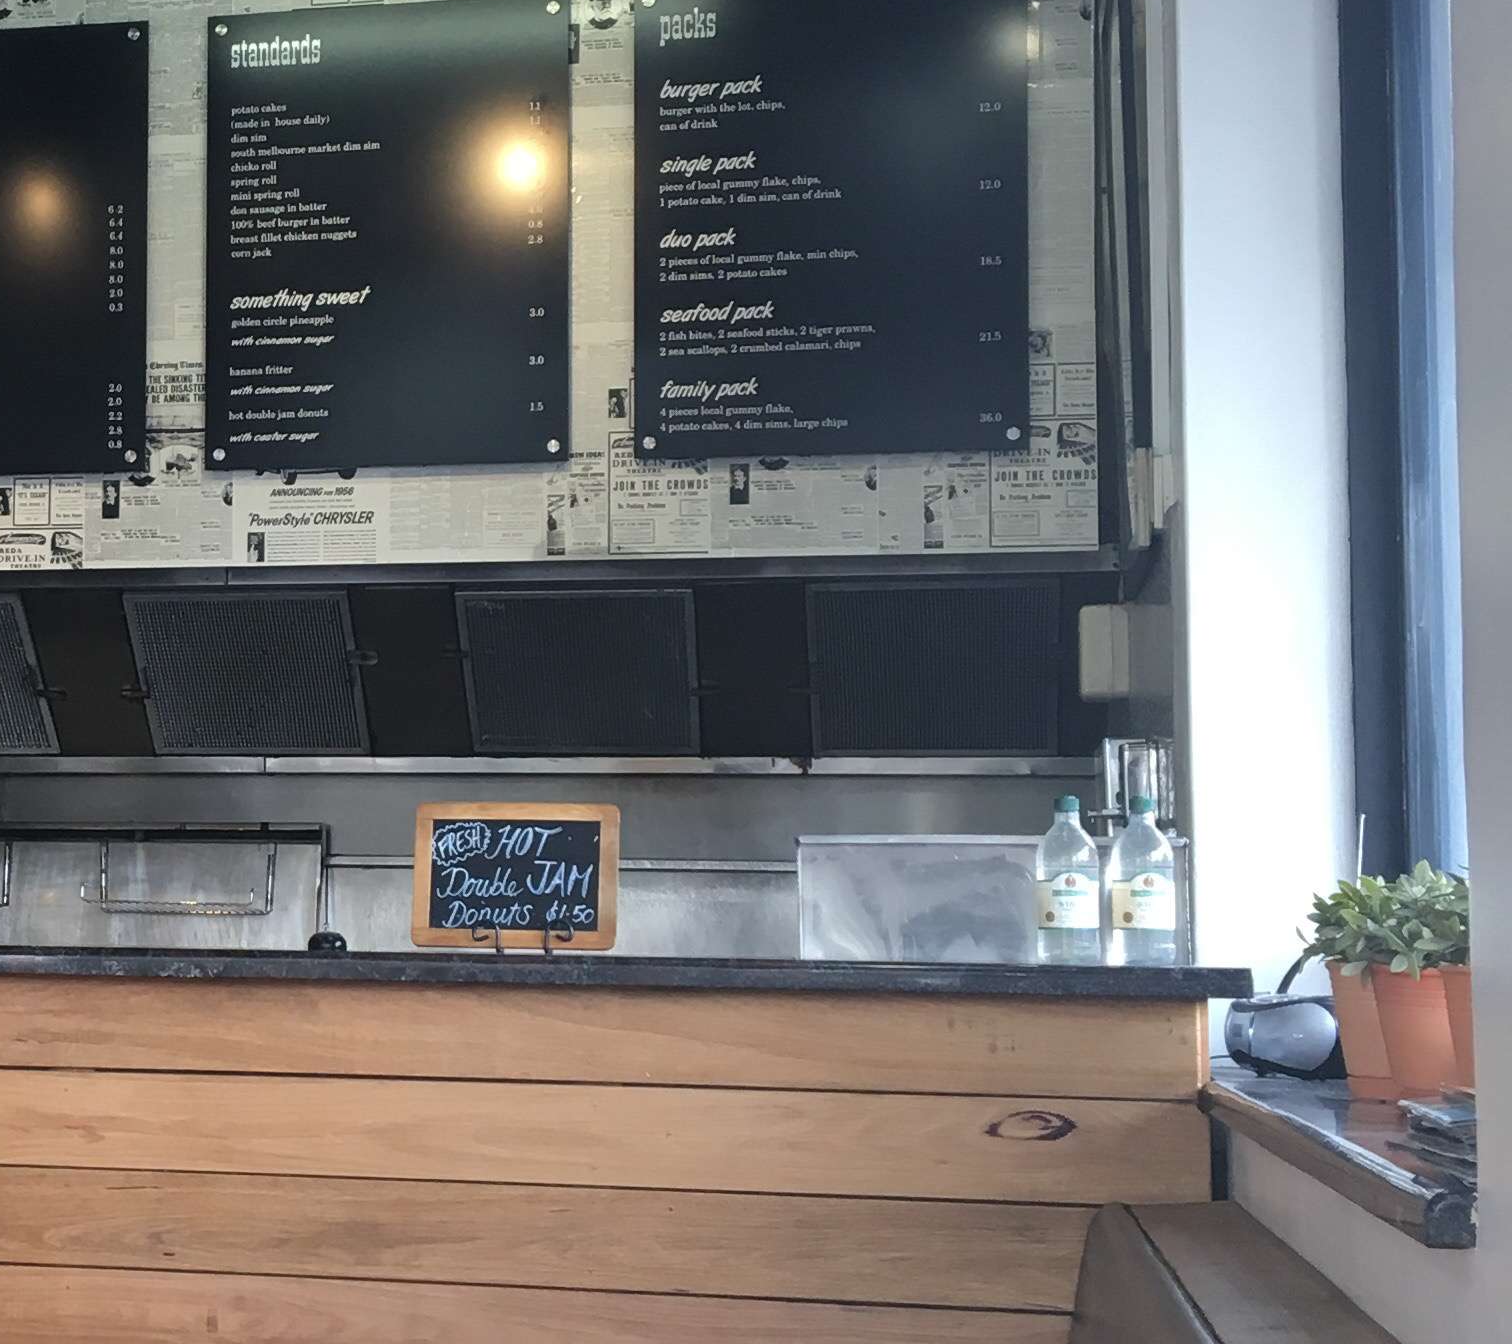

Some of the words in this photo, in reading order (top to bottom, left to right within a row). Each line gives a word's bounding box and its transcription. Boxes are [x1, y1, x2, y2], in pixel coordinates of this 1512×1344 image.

[659, 7, 717, 47] packs
[230, 33, 322, 69] standards
[660, 79, 720, 103] burger
[719, 74, 762, 100] pack
[659, 106, 693, 117] burger
[694, 104, 717, 114] with
[719, 102, 736, 114] the
[274, 116, 301, 126] house
[659, 123, 678, 131] can
[680, 119, 689, 130] of
[691, 118, 718, 129] drink
[660, 154, 710, 177] single
[714, 151, 757, 174] pack
[697, 179, 721, 190] local
[722, 178, 759, 191] gummy
[979, 179, 1002, 190] 12.0
[230, 189, 252, 201] mini
[253, 189, 283, 202] spring
[284, 188, 301, 199] roll
[283, 230, 319, 241] chicken
[321, 229, 357, 242] nuggets
[527, 234, 543, 245] 2.8
[660, 228, 691, 249] duo
[693, 228, 736, 251] pack
[726, 268, 757, 280] potato
[759, 267, 788, 278] cakes
[229, 288, 313, 313] something
[315, 285, 372, 307] sweet
[231, 315, 261, 328] golden
[262, 314, 288, 326] circle
[289, 314, 334, 328] pineapple
[529, 307, 545, 318] 3.0
[660, 302, 735, 324] seafood
[730, 301, 775, 325] pack
[979, 331, 1002, 342] 21.5
[229, 365, 264, 376] banana
[265, 364, 293, 376] fritter
[529, 355, 545, 366] 3.0
[230, 384, 253, 396] with
[254, 383, 301, 395] cinnamon
[303, 382, 334, 395] sugar
[660, 380, 716, 402] family
[715, 377, 758, 401] pack
[229, 409, 244, 420] hot
[245, 408, 276, 420] double
[277, 409, 297, 421] jam
[297, 408, 329, 419] donuts
[979, 412, 1002, 423] 36.0
[270, 487, 324, 496] ANNOUNCING
[334, 487, 354, 496] 1956
[613, 480, 635, 491] JOIN
[642, 480, 660, 490] THE
[667, 479, 709, 490] CROWDS
[313, 511, 374, 525] CHRYSLER
[438, 826, 482, 859] FRESH
[485, 824, 563, 860] HOT
[437, 867, 523, 899] Double
[526, 860, 593, 898] JAM
[442, 900, 533, 928] Donuts
